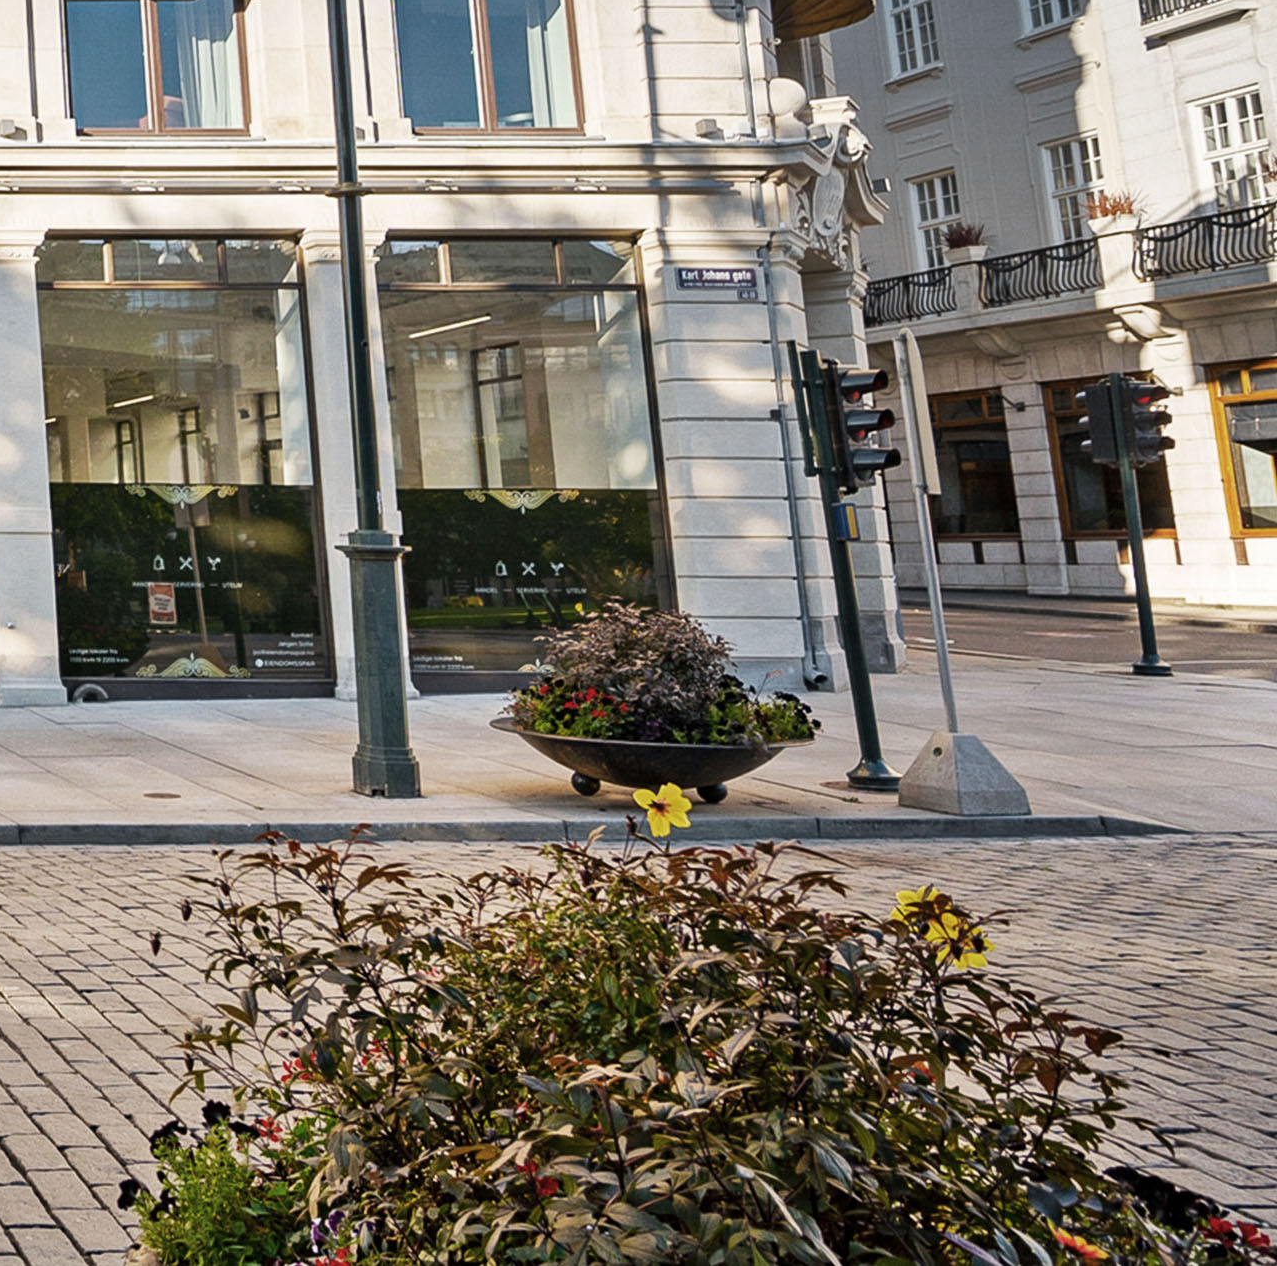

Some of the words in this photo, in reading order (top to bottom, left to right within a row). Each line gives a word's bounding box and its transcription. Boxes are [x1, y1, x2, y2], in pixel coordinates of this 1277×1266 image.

[681, 270, 698, 280] Karl
[702, 270, 730, 281] Johans
[732, 270, 751, 283] gate
